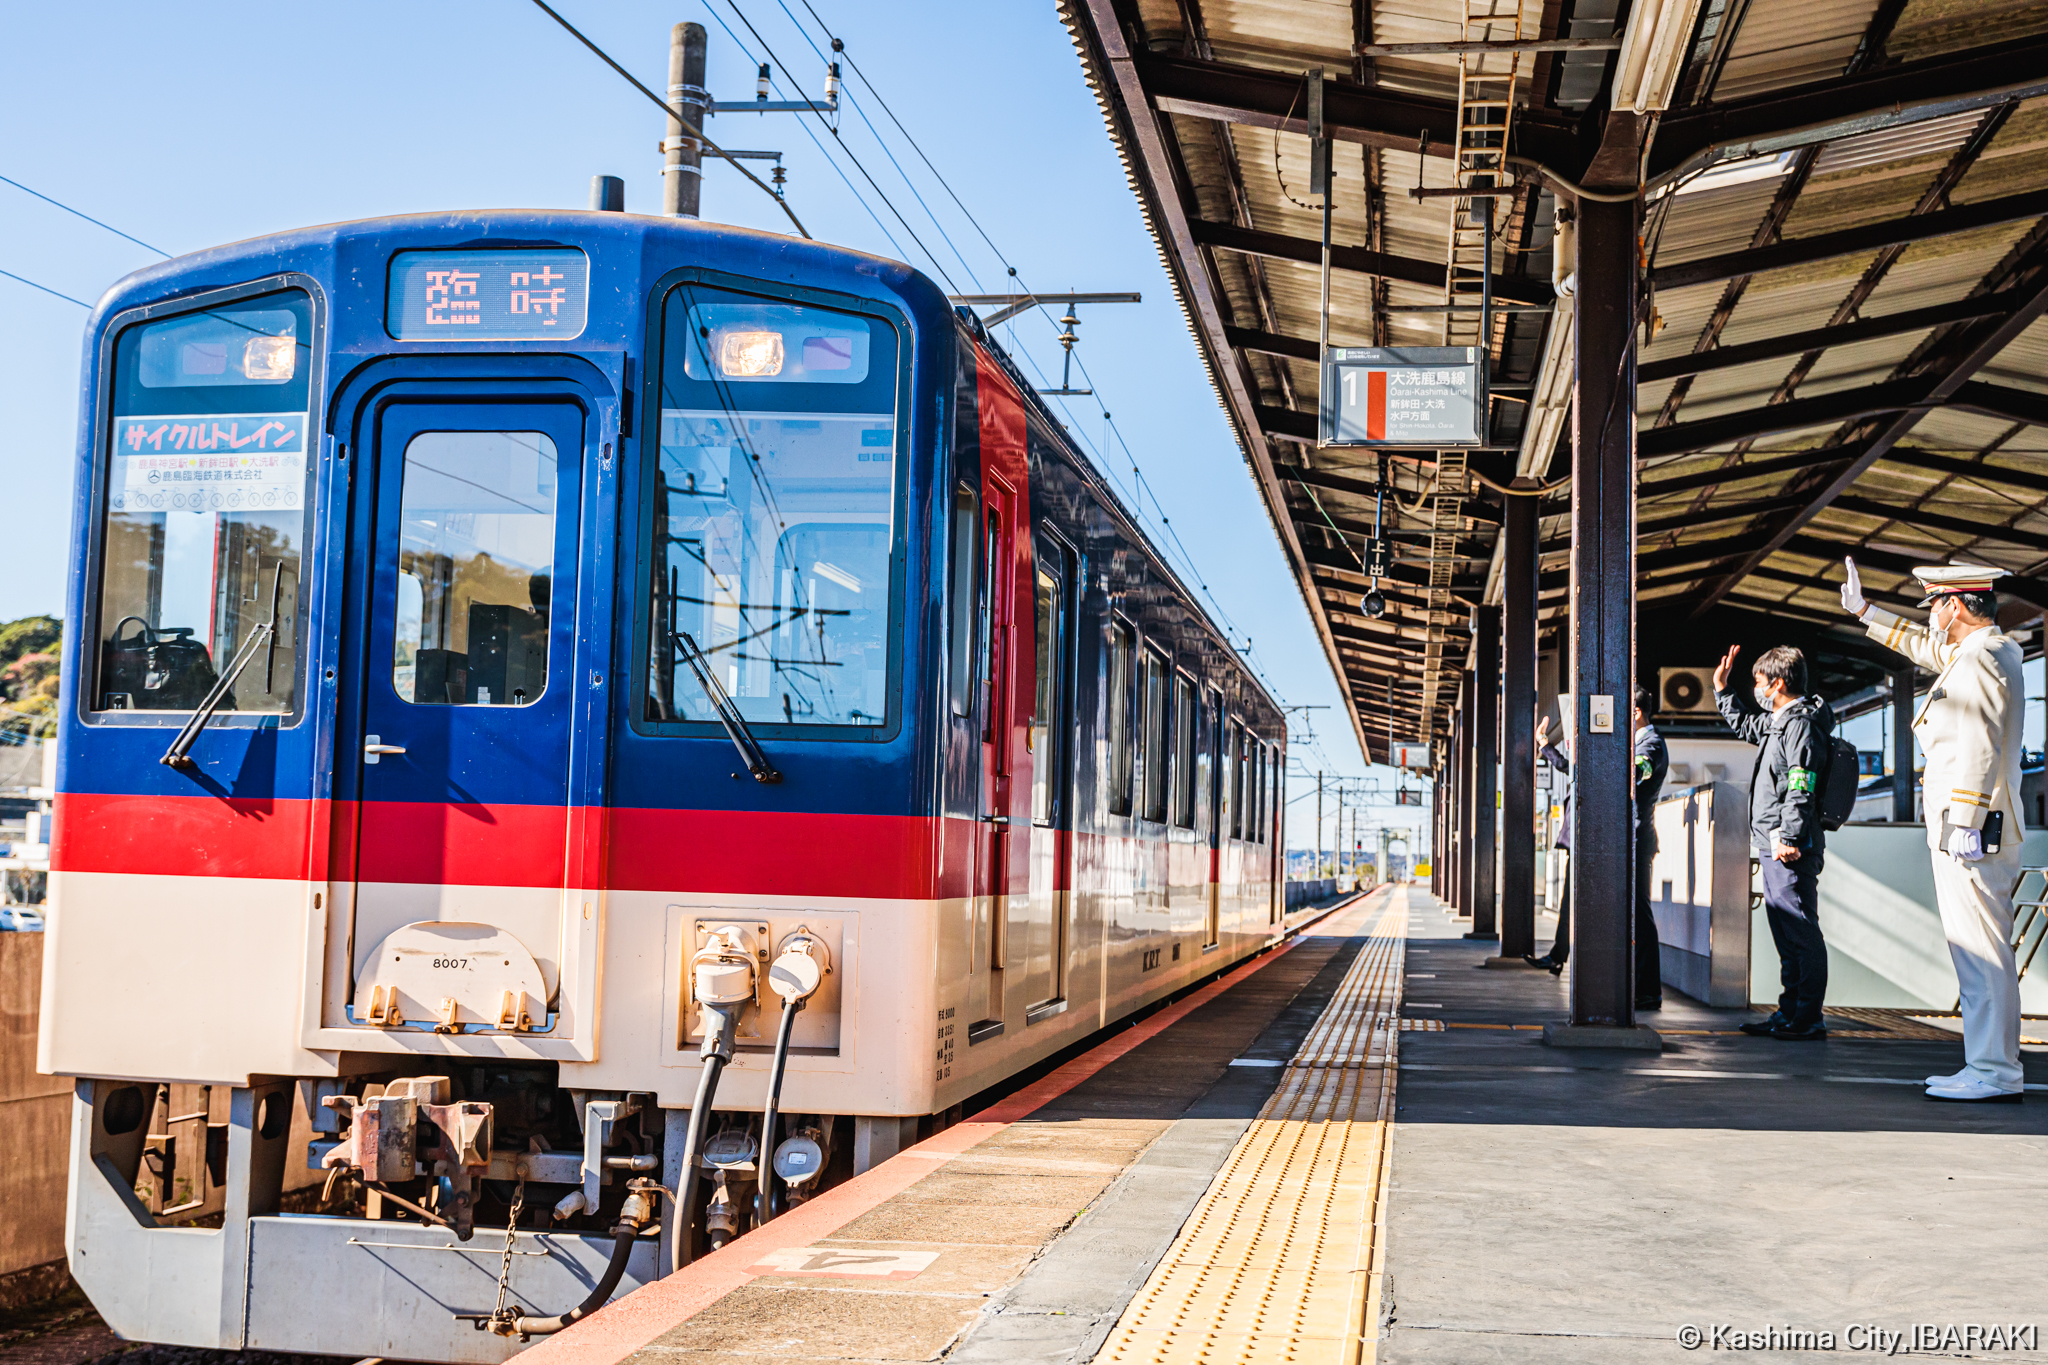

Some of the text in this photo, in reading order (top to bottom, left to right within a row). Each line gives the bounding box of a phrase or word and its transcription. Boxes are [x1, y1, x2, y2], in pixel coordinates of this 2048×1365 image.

[426, 265, 568, 326] 臨時
[1390, 371, 1466, 386] 大洗鹿島線
[1342, 371, 1357, 407] 1
[1450, 387, 1467, 396] Line
[1389, 411, 1430, 421] 水戸方面
[126, 420, 297, 452] サイクルトレイン
[138, 455, 279, 470] 鹿島神宮駅 新鉾田駅 大洗駅
[162, 468, 263, 482] 鹿島臨海鉄道株式会社
[432, 958, 468, 969] 8007
